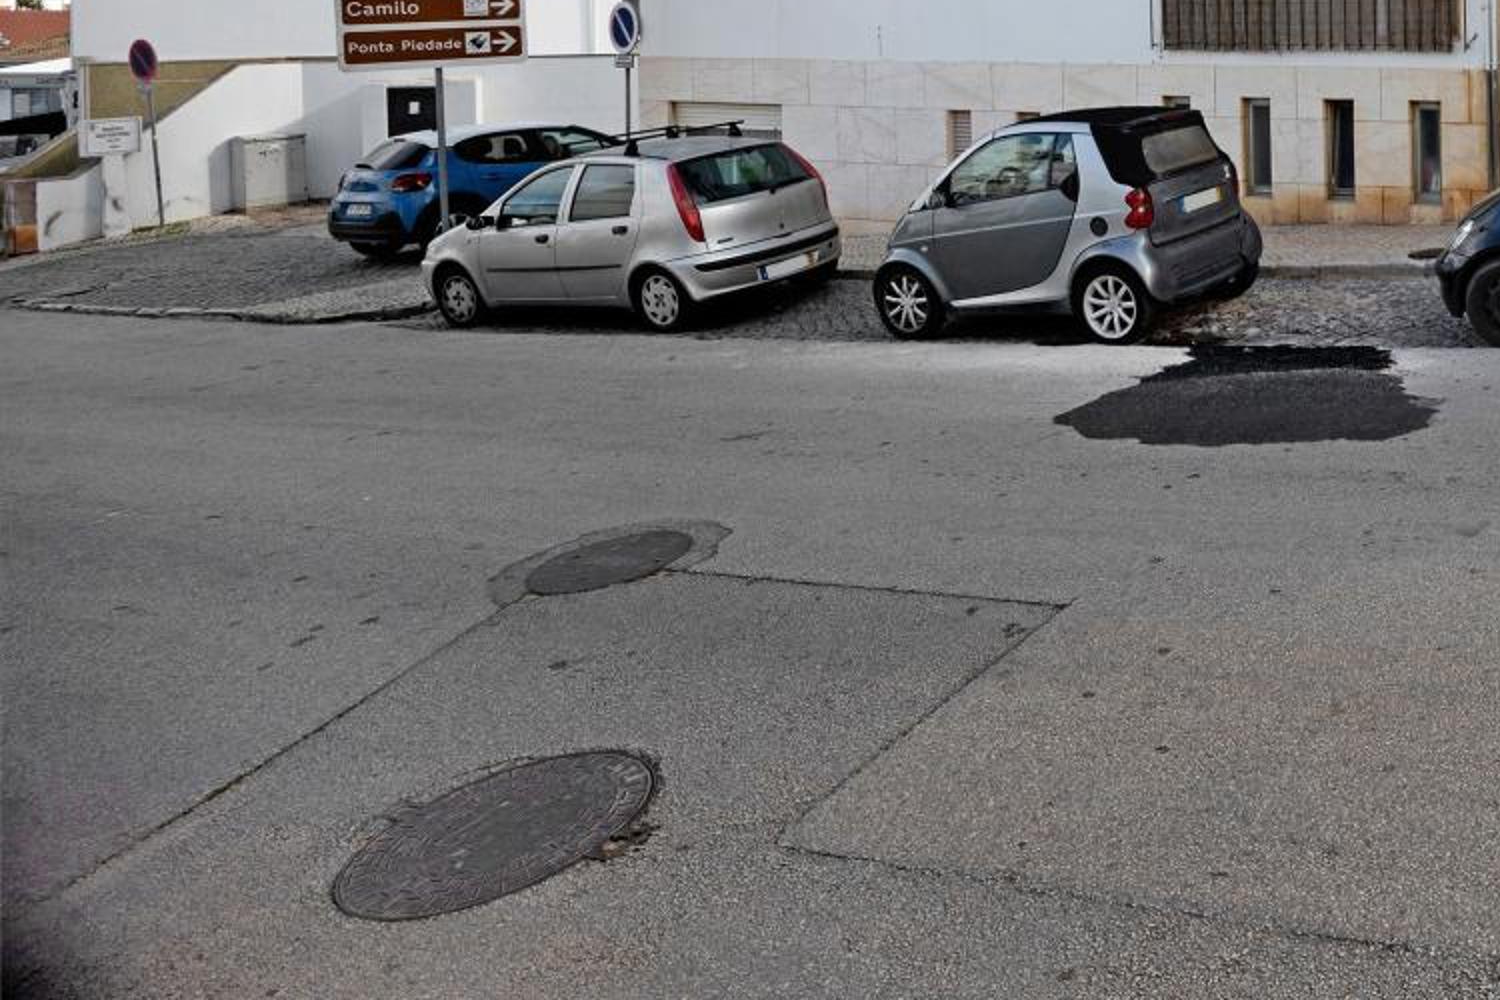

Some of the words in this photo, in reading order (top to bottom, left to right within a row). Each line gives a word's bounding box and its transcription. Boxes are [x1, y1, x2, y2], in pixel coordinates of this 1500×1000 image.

[346, 1, 419, 17] Camilo
[347, 42, 394, 55] Ponta
[400, 38, 462, 51] Piedade
